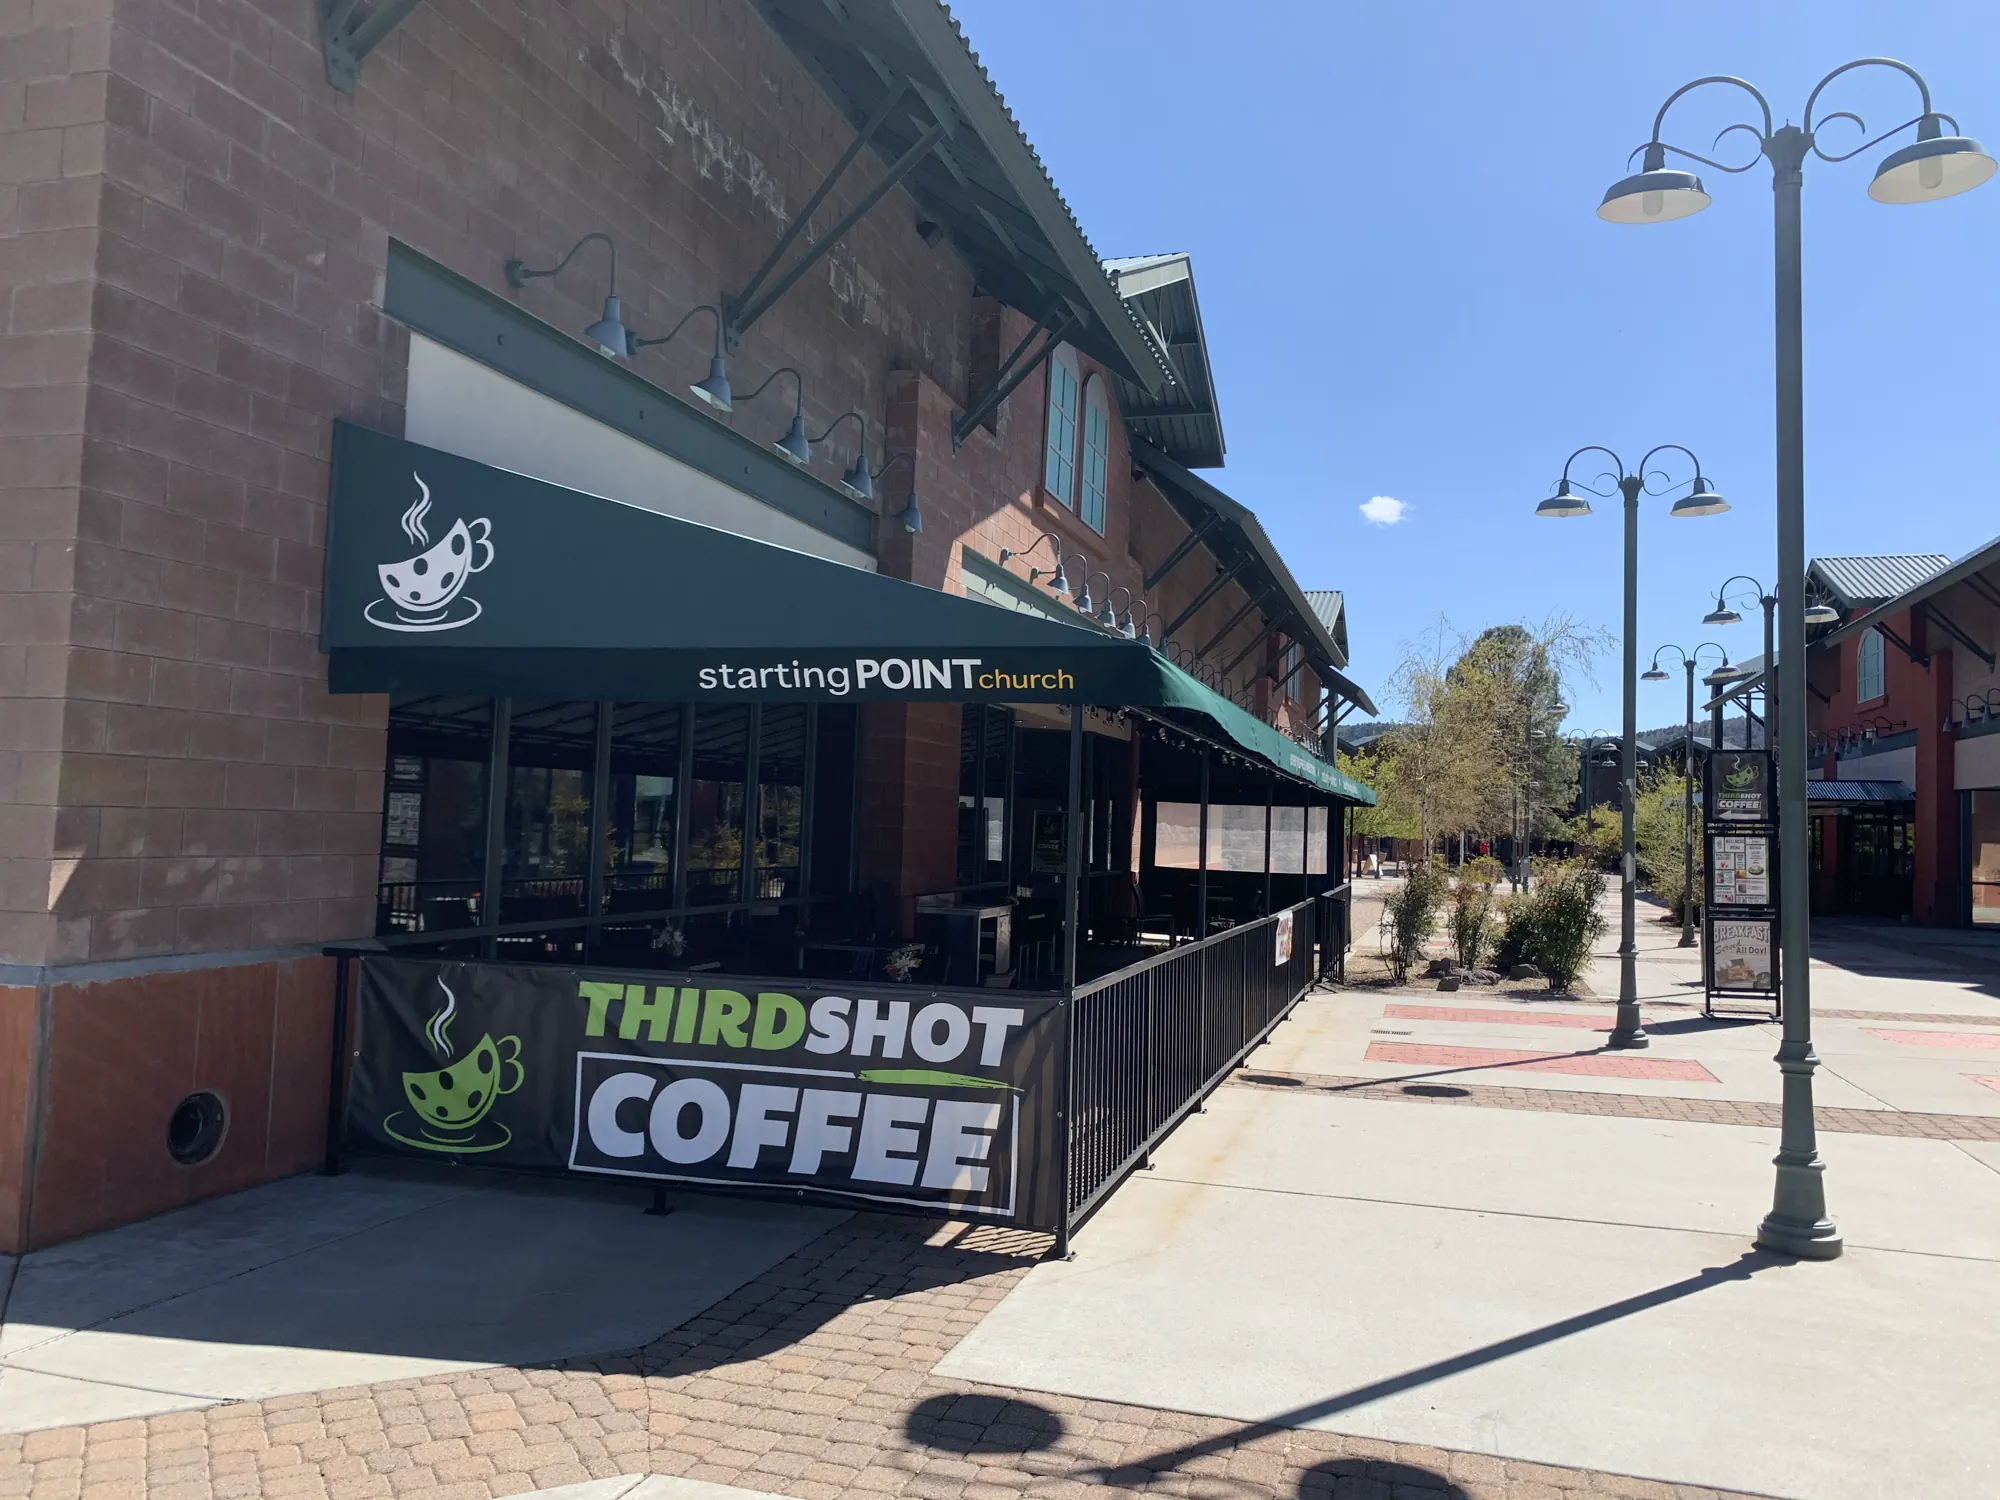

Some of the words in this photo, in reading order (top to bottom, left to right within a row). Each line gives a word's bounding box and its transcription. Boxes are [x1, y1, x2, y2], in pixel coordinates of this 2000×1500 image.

[1719, 800, 1760, 809] COFFEE
[1714, 925, 1770, 943] BREAKFAST
[1736, 946, 1747, 954] All
[1748, 946, 1767, 955] Day!
[587, 1071, 1002, 1193] COFFEE
